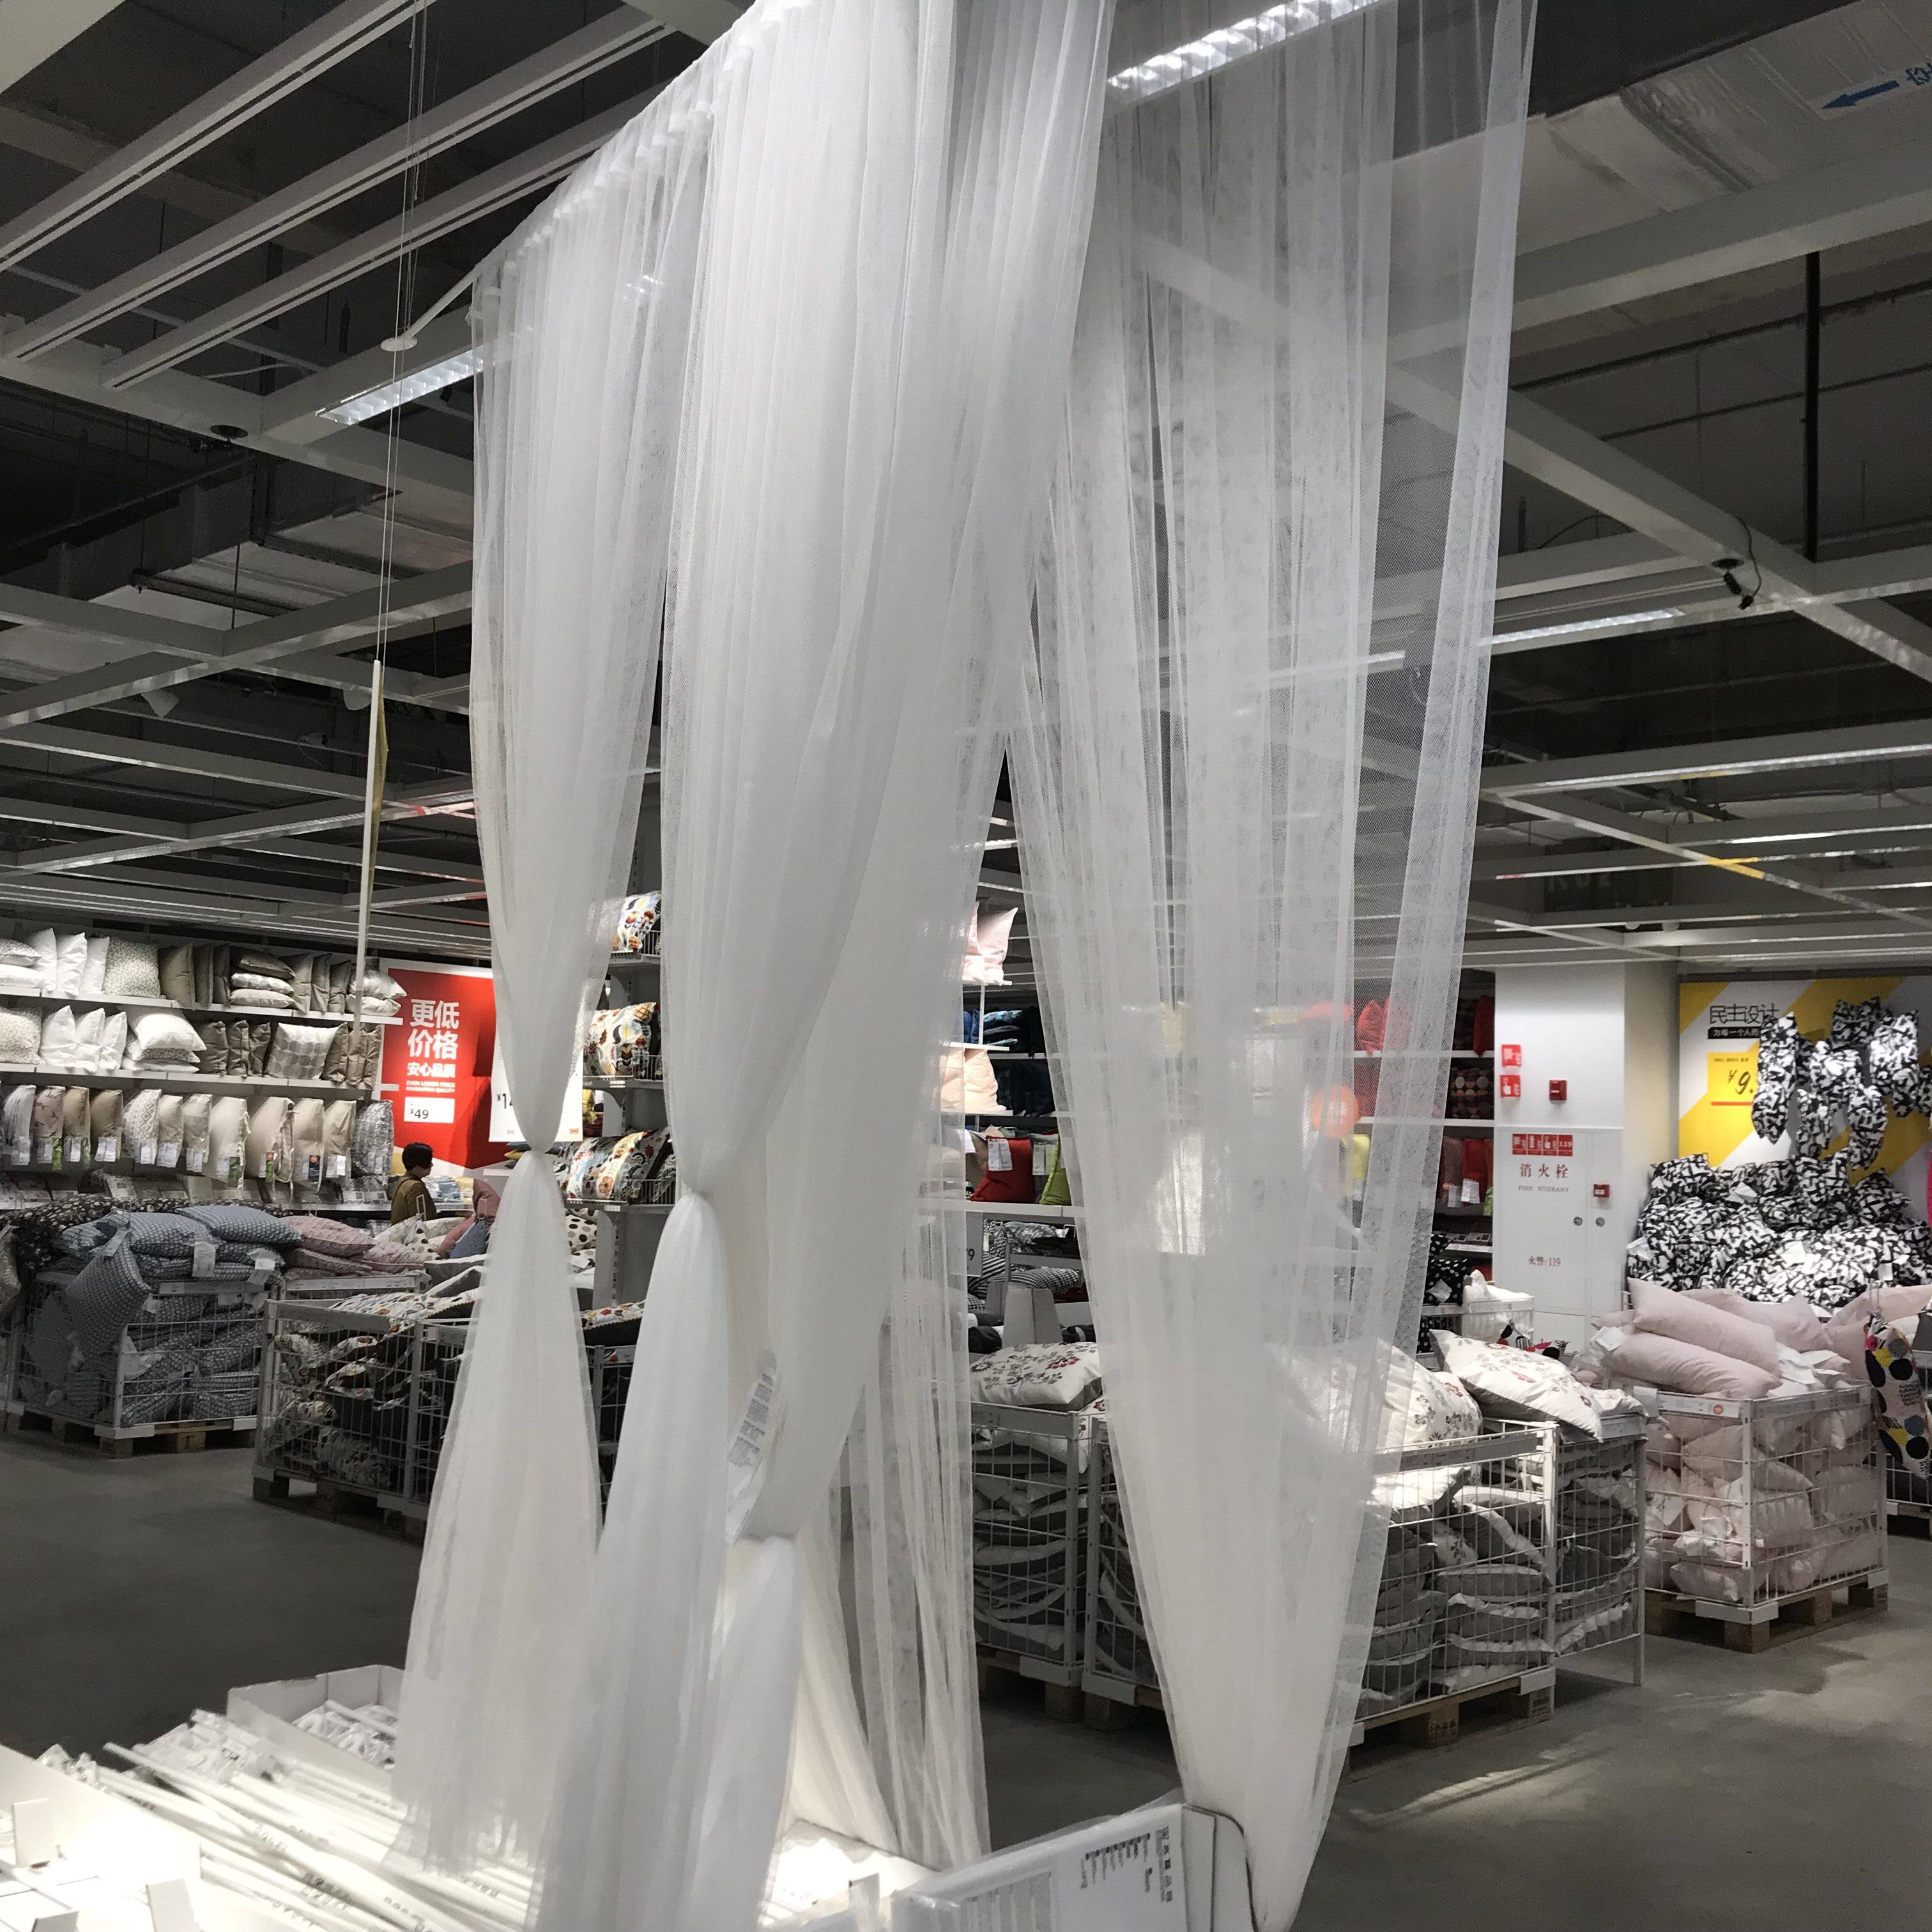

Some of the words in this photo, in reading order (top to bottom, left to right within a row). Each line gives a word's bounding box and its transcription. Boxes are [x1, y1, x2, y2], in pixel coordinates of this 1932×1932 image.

[410, 999, 460, 1029] 更低
[1710, 1003, 1779, 1024] 民主设计
[408, 1029, 459, 1060] 价格
[410, 1108, 429, 1119] ¥49
[1520, 1163, 1568, 1179] 消火栓
